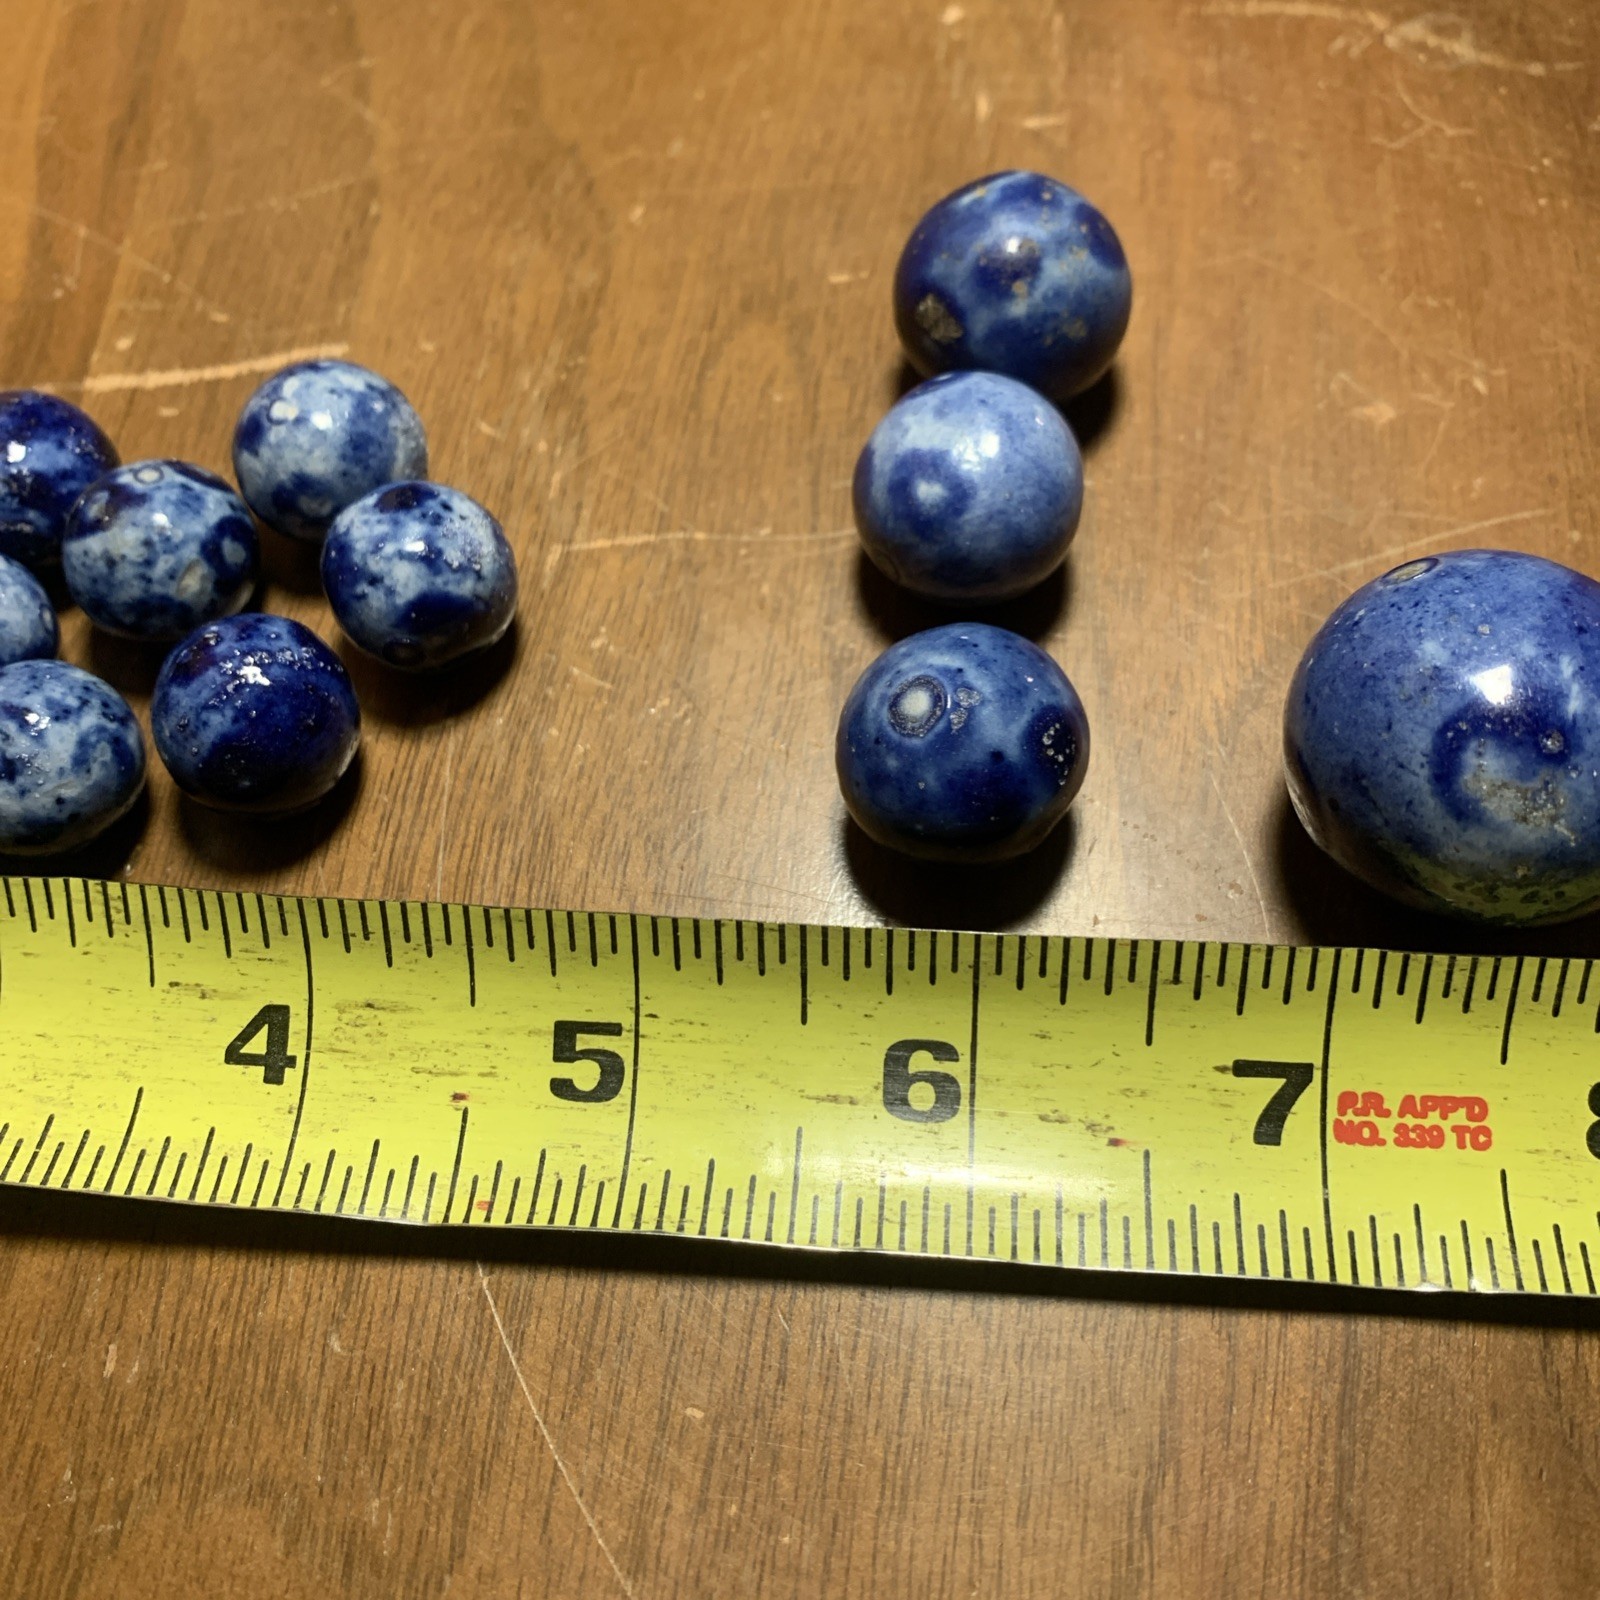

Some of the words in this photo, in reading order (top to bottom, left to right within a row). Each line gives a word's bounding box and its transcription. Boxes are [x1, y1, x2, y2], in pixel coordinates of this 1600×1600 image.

[224, 1004, 297, 1086] 4
[550, 1020, 626, 1103] 5
[882, 1039, 962, 1123] 6
[1232, 1059, 1314, 1147] 7
[1332, 1118, 1387, 1147] NO.
[1451, 1125, 1493, 1152] TC
[1397, 1095, 1489, 1123] APP'D
